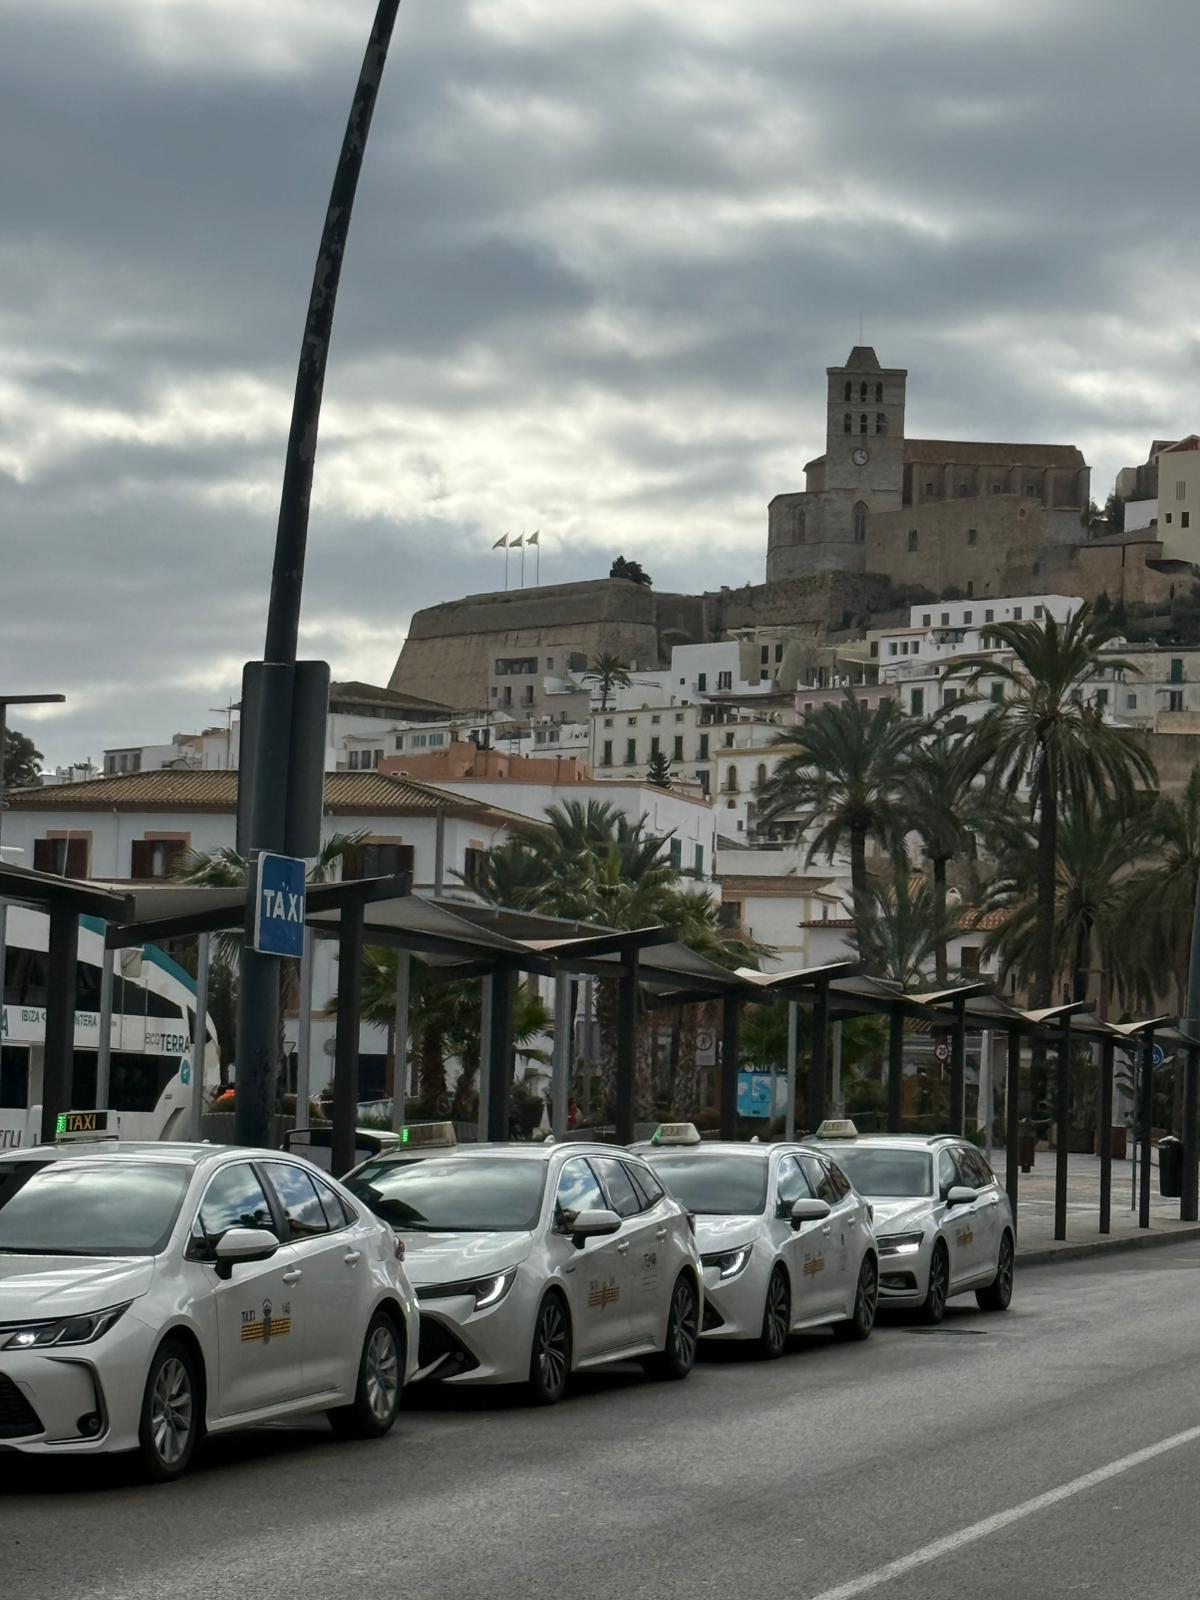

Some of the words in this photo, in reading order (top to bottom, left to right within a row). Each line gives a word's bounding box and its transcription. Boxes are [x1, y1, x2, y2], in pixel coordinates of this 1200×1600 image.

[263, 889, 304, 923] TAXI
[22, 1009, 40, 1023] IBIZA
[68, 1114, 97, 1131] TAXI
